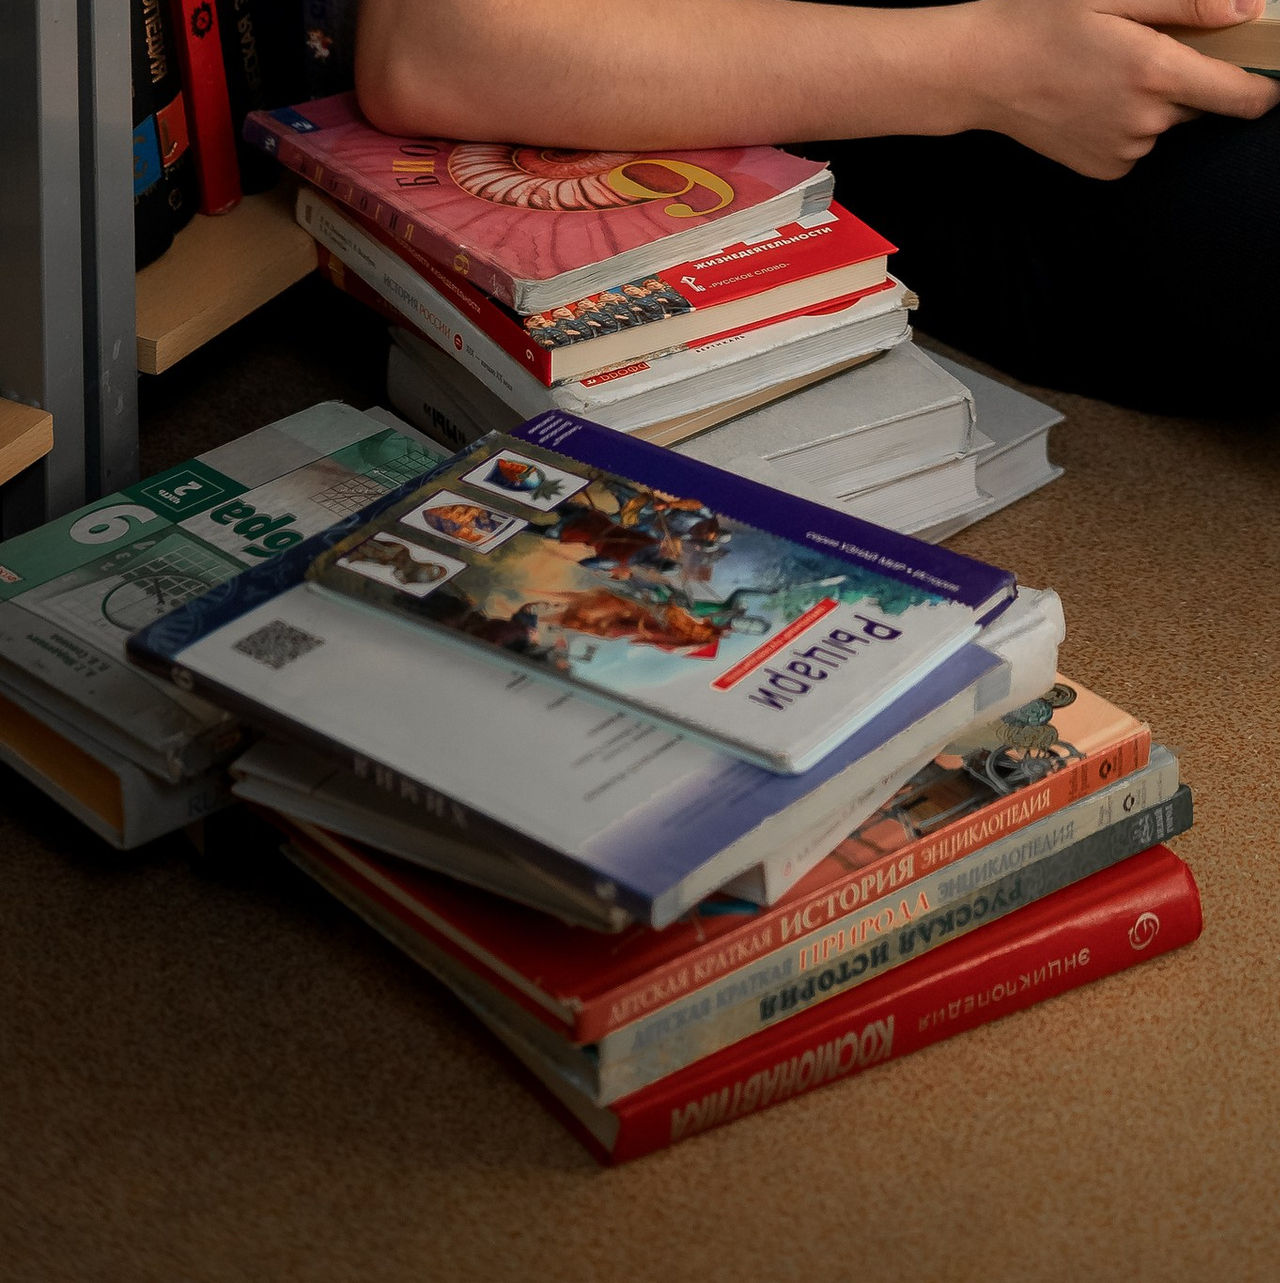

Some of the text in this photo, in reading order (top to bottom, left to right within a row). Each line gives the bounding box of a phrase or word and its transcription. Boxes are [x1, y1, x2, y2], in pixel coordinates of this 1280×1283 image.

[608, 159, 735, 218] 9
[693, 226, 833, 271] ЖИЗНЕДЕЯТЕЛЬНОСТИ
[383, 272, 420, 311] ИСТОРИЯ
[418, 305, 452, 342] РОССИИ
[69, 502, 158, 545] 9
[839, 540, 880, 562] УЗНАЙ
[878, 554, 906, 571] МИР
[746, 613, 903, 714] Рыцари
[609, 968, 691, 1023] ДЕТСКАЯ
[694, 930, 773, 986] КРАТКАЯ
[780, 846, 917, 948] ИСТОРИЯ
[920, 788, 1051, 875] ЭНЦИКЛОПЕДИЯ
[797, 891, 931, 974] ПРИРОДА
[937, 821, 1075, 907] ЭНЦИКЛОПЕДИЯ
[759, 875, 1024, 1023] РУССКАЯ ИСТОРИЯ
[917, 946, 1091, 1033] ЭНЦИКЛОПЕДИЯ
[669, 1014, 897, 1138] КОСМОНАВТИКА
